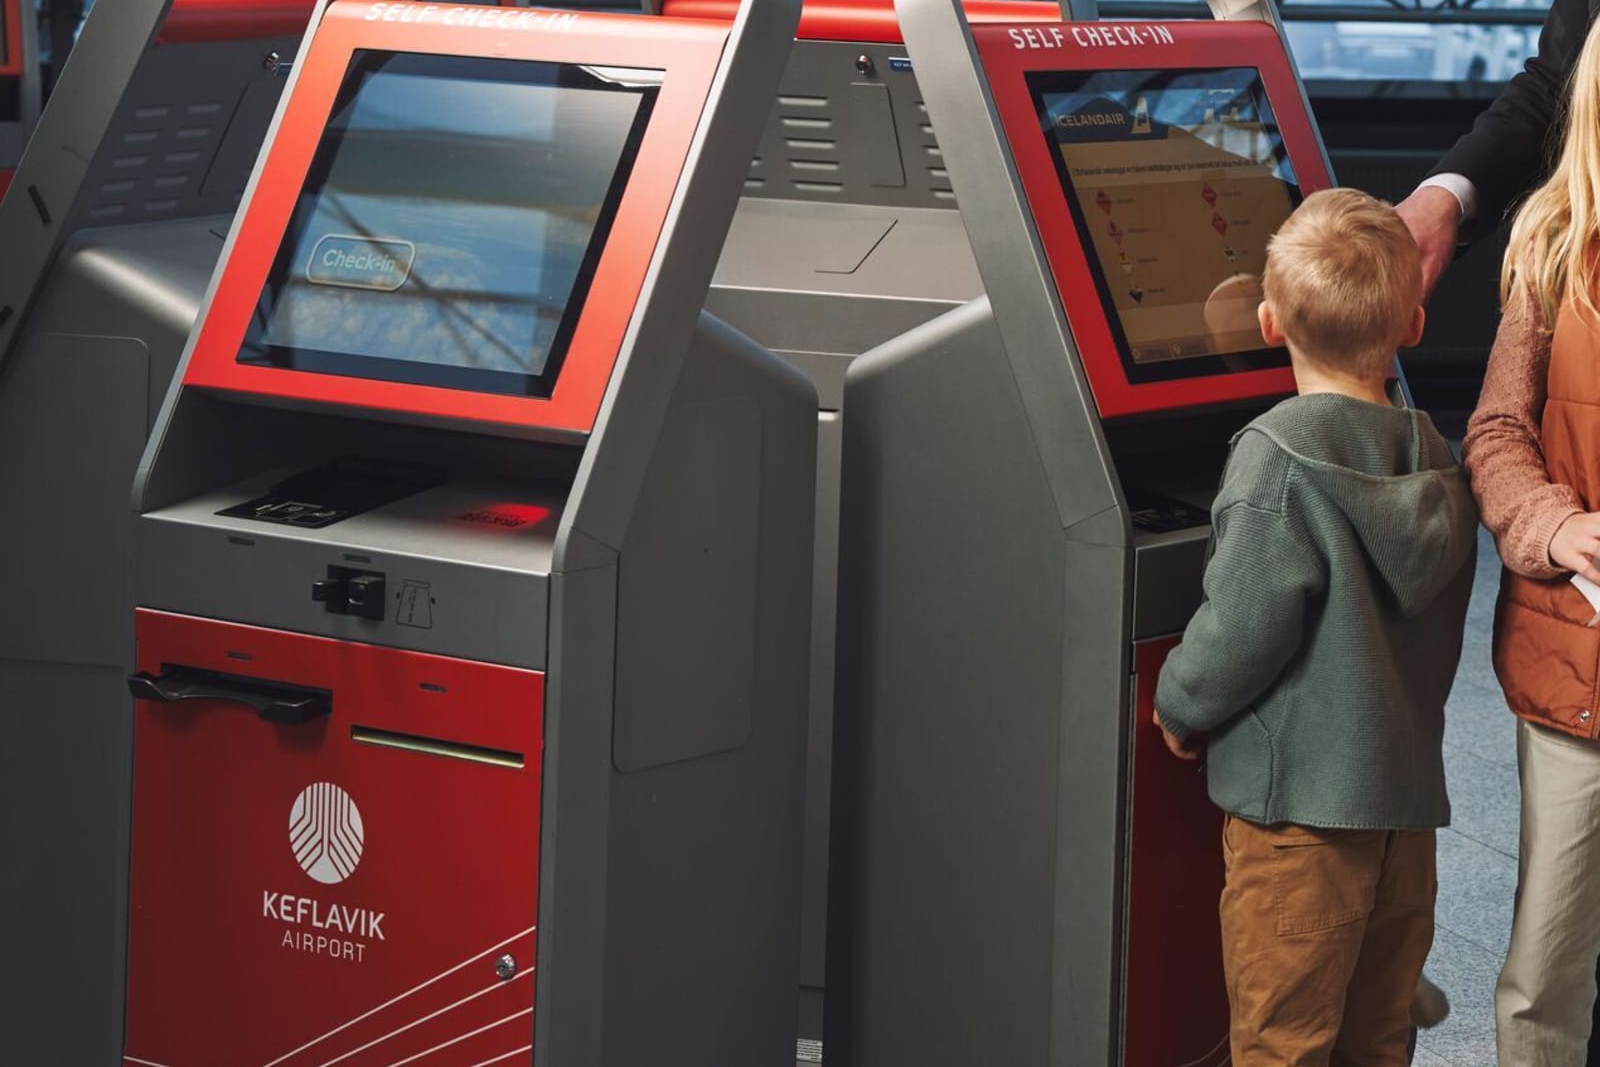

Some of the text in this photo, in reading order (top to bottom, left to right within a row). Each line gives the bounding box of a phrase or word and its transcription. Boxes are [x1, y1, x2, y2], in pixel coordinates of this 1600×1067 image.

[364, 2, 579, 30] SELF CHECK-IN
[1008, 25, 1174, 50] SELF CHECK-IN
[1055, 113, 1126, 127] ICELANDAIR
[322, 248, 396, 273] Check-in
[263, 890, 385, 941] KEFLAVIK
[282, 930, 366, 962] AIRPORT
